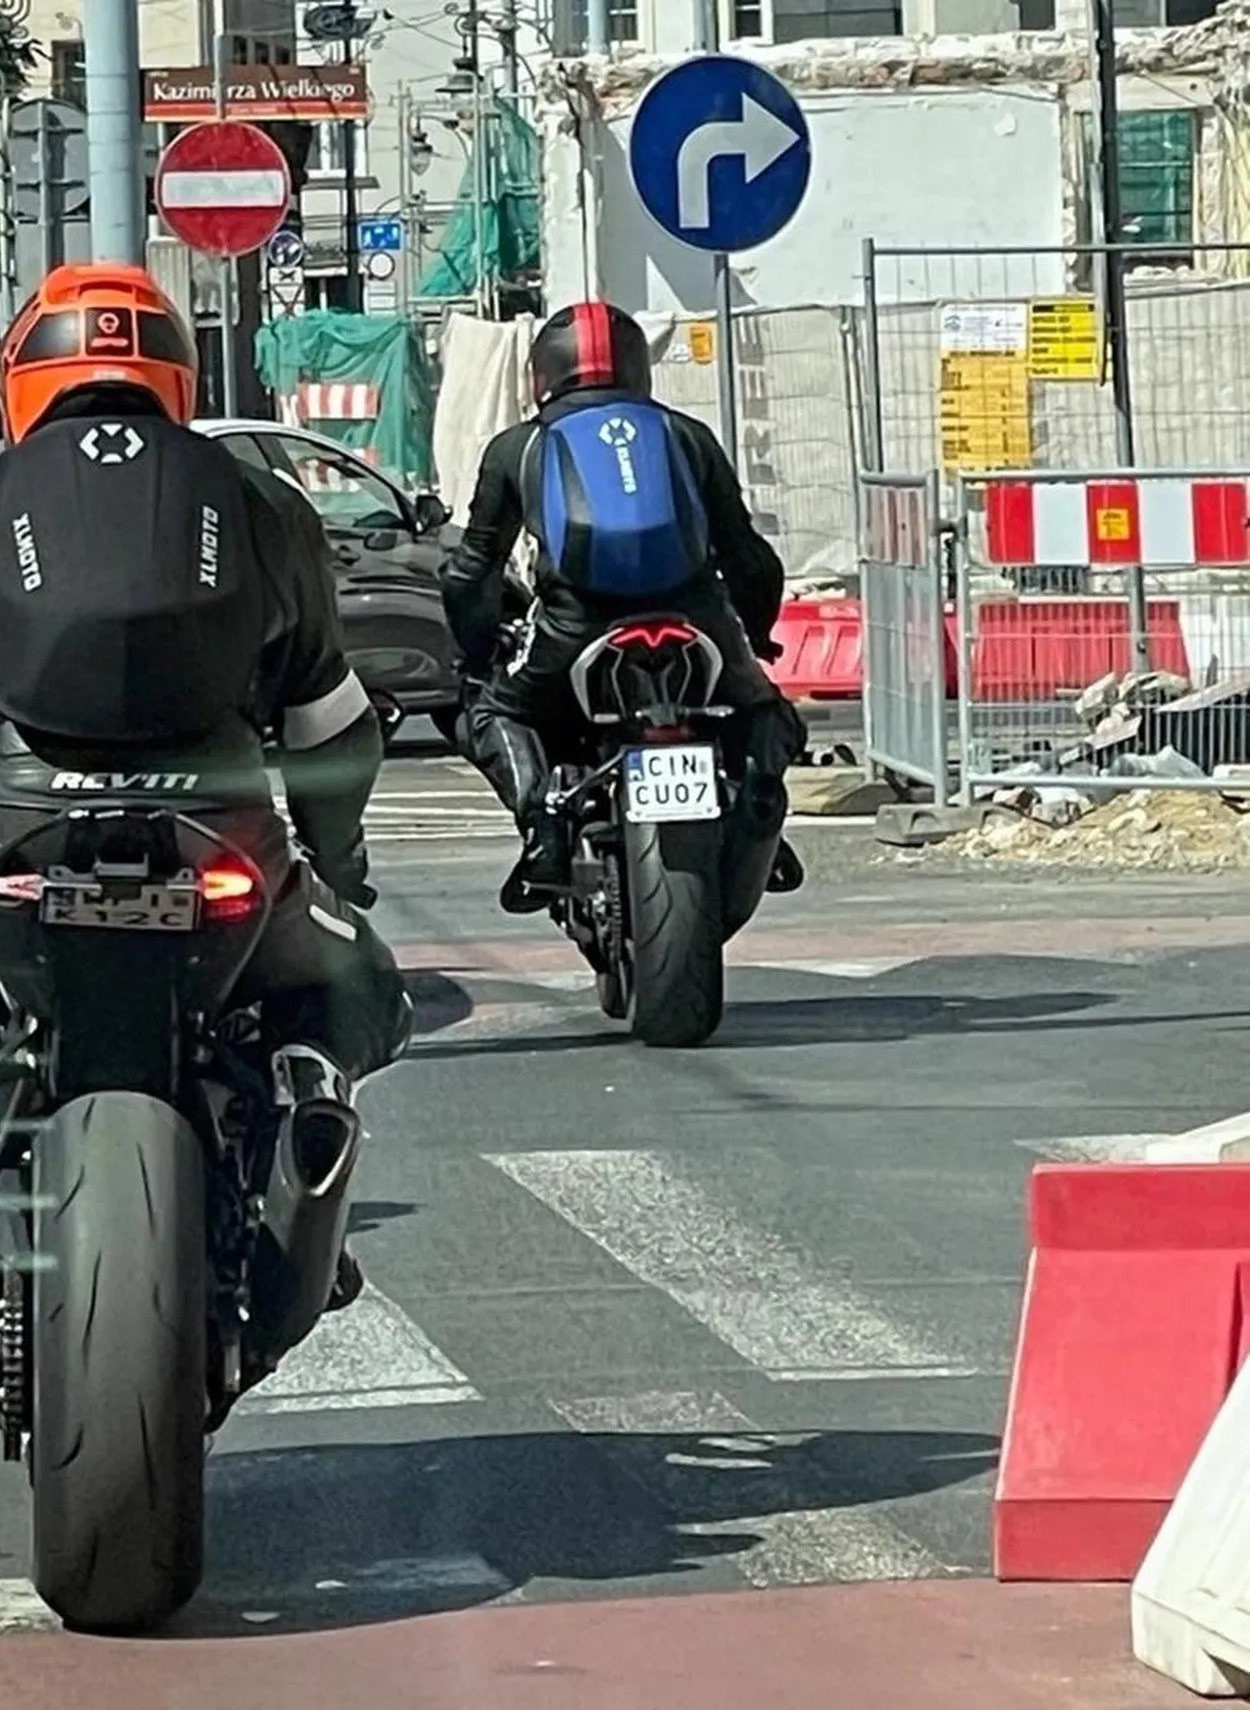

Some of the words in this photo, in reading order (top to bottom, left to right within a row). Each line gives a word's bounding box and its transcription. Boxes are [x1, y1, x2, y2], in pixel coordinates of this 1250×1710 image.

[154, 81, 256, 101] Kazimirza
[12, 512, 42, 592] XLMOTO
[199, 506, 219, 587] XLMOTO
[649, 754, 697, 777] CIN
[635, 782, 708, 805] CU07
